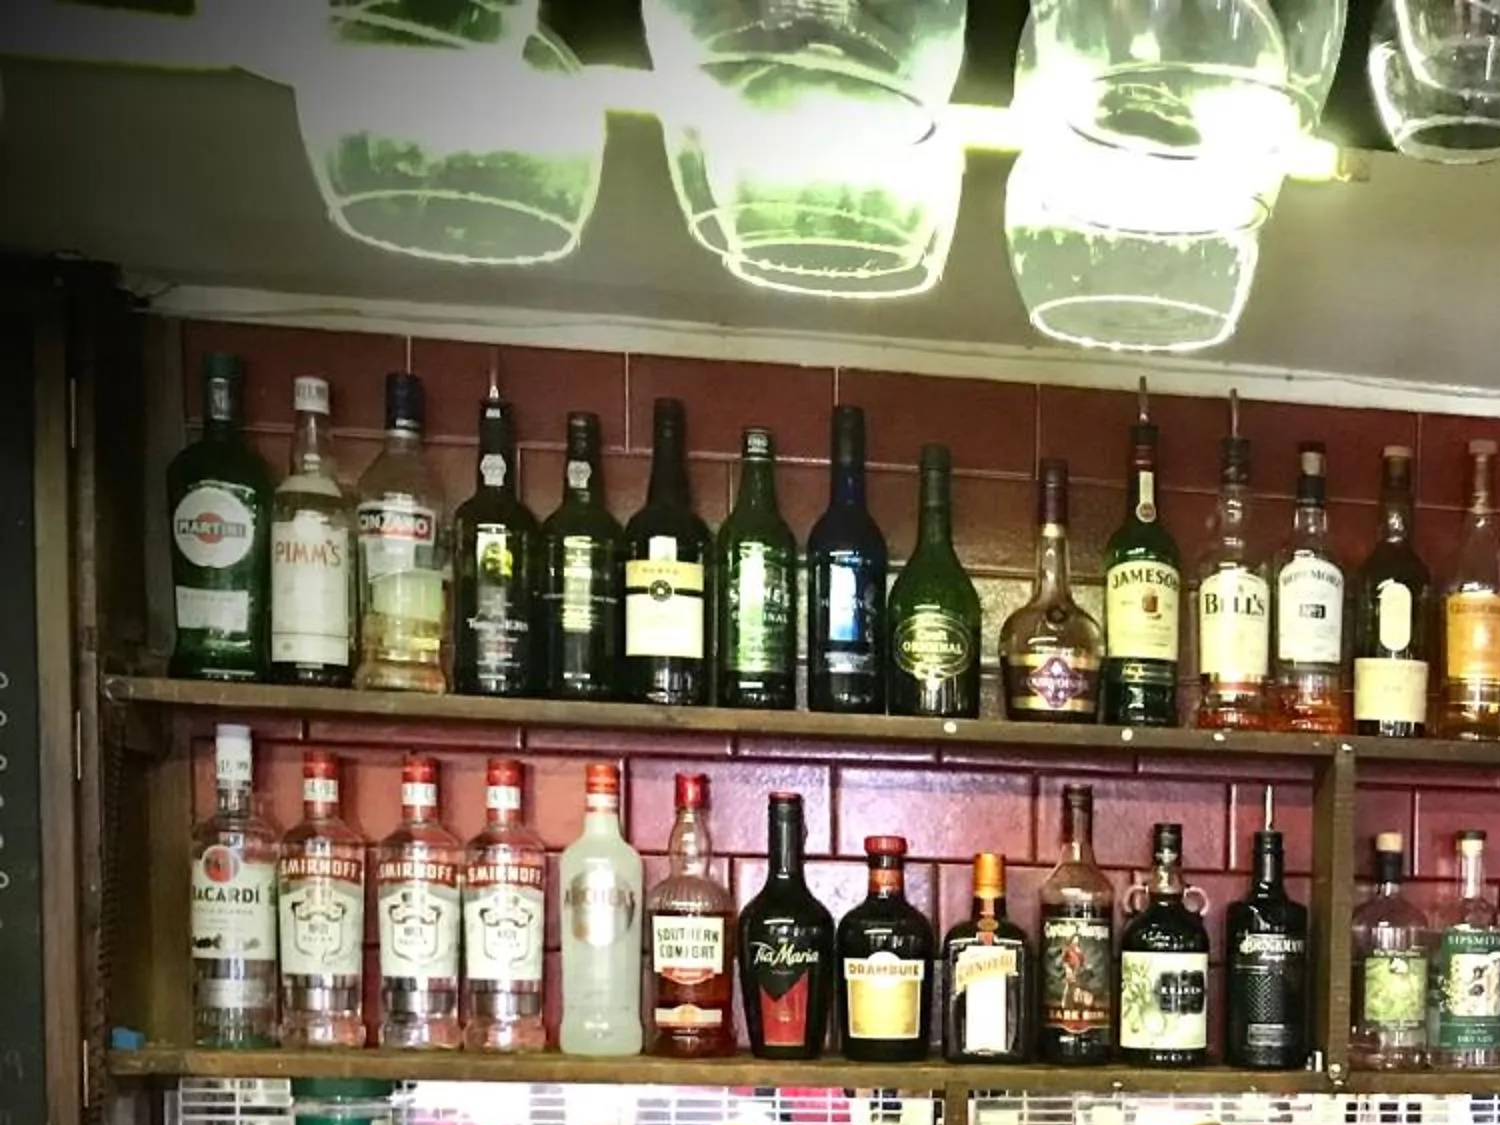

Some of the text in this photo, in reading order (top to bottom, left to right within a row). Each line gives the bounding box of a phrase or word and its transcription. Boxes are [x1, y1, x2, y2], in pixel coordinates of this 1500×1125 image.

[274, 538, 342, 568] PIMM'S
[280, 857, 358, 879] SMIRNOFF
[379, 862, 453, 883] SMIRNOFF
[467, 867, 541, 885] SMIRNOFF
[751, 942, 820, 966] Tia Maria
[848, 962, 920, 977] DRAMBUIE
